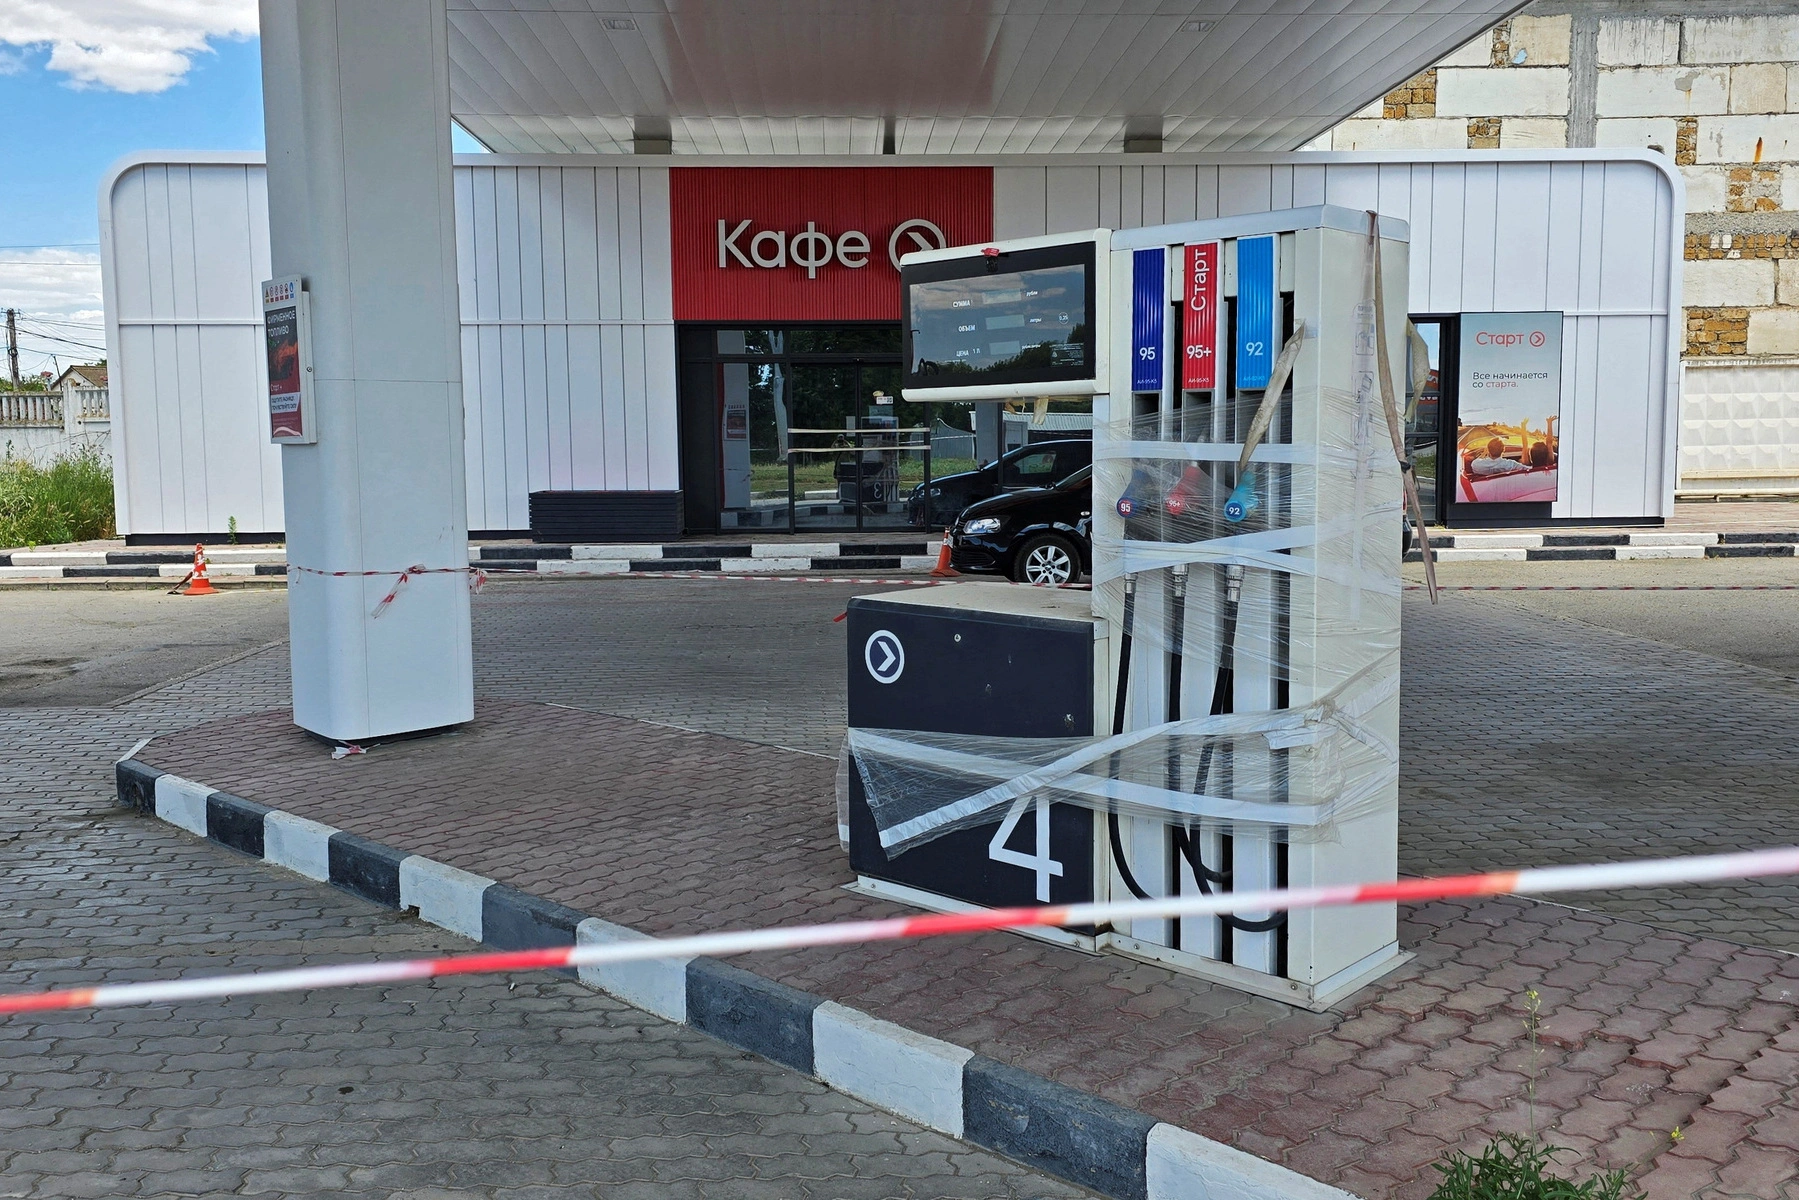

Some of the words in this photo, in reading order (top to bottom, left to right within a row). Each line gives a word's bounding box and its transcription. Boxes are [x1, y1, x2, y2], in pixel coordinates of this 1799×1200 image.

[717, 219, 871, 279] Кафе
[1190, 248, 1210, 311] Старт
[1476, 331, 1524, 347] Старт
[1139, 346, 1156, 361] 95
[1186, 344, 1212, 359] 95+
[1245, 341, 1264, 356] 92
[1472, 371, 1490, 380] Все
[1492, 371, 1548, 380] начинается
[1485, 381, 1519, 389] старта.
[1120, 502, 1131, 513] 95
[1228, 507, 1240, 515] 92
[988, 795, 1064, 904] 4
